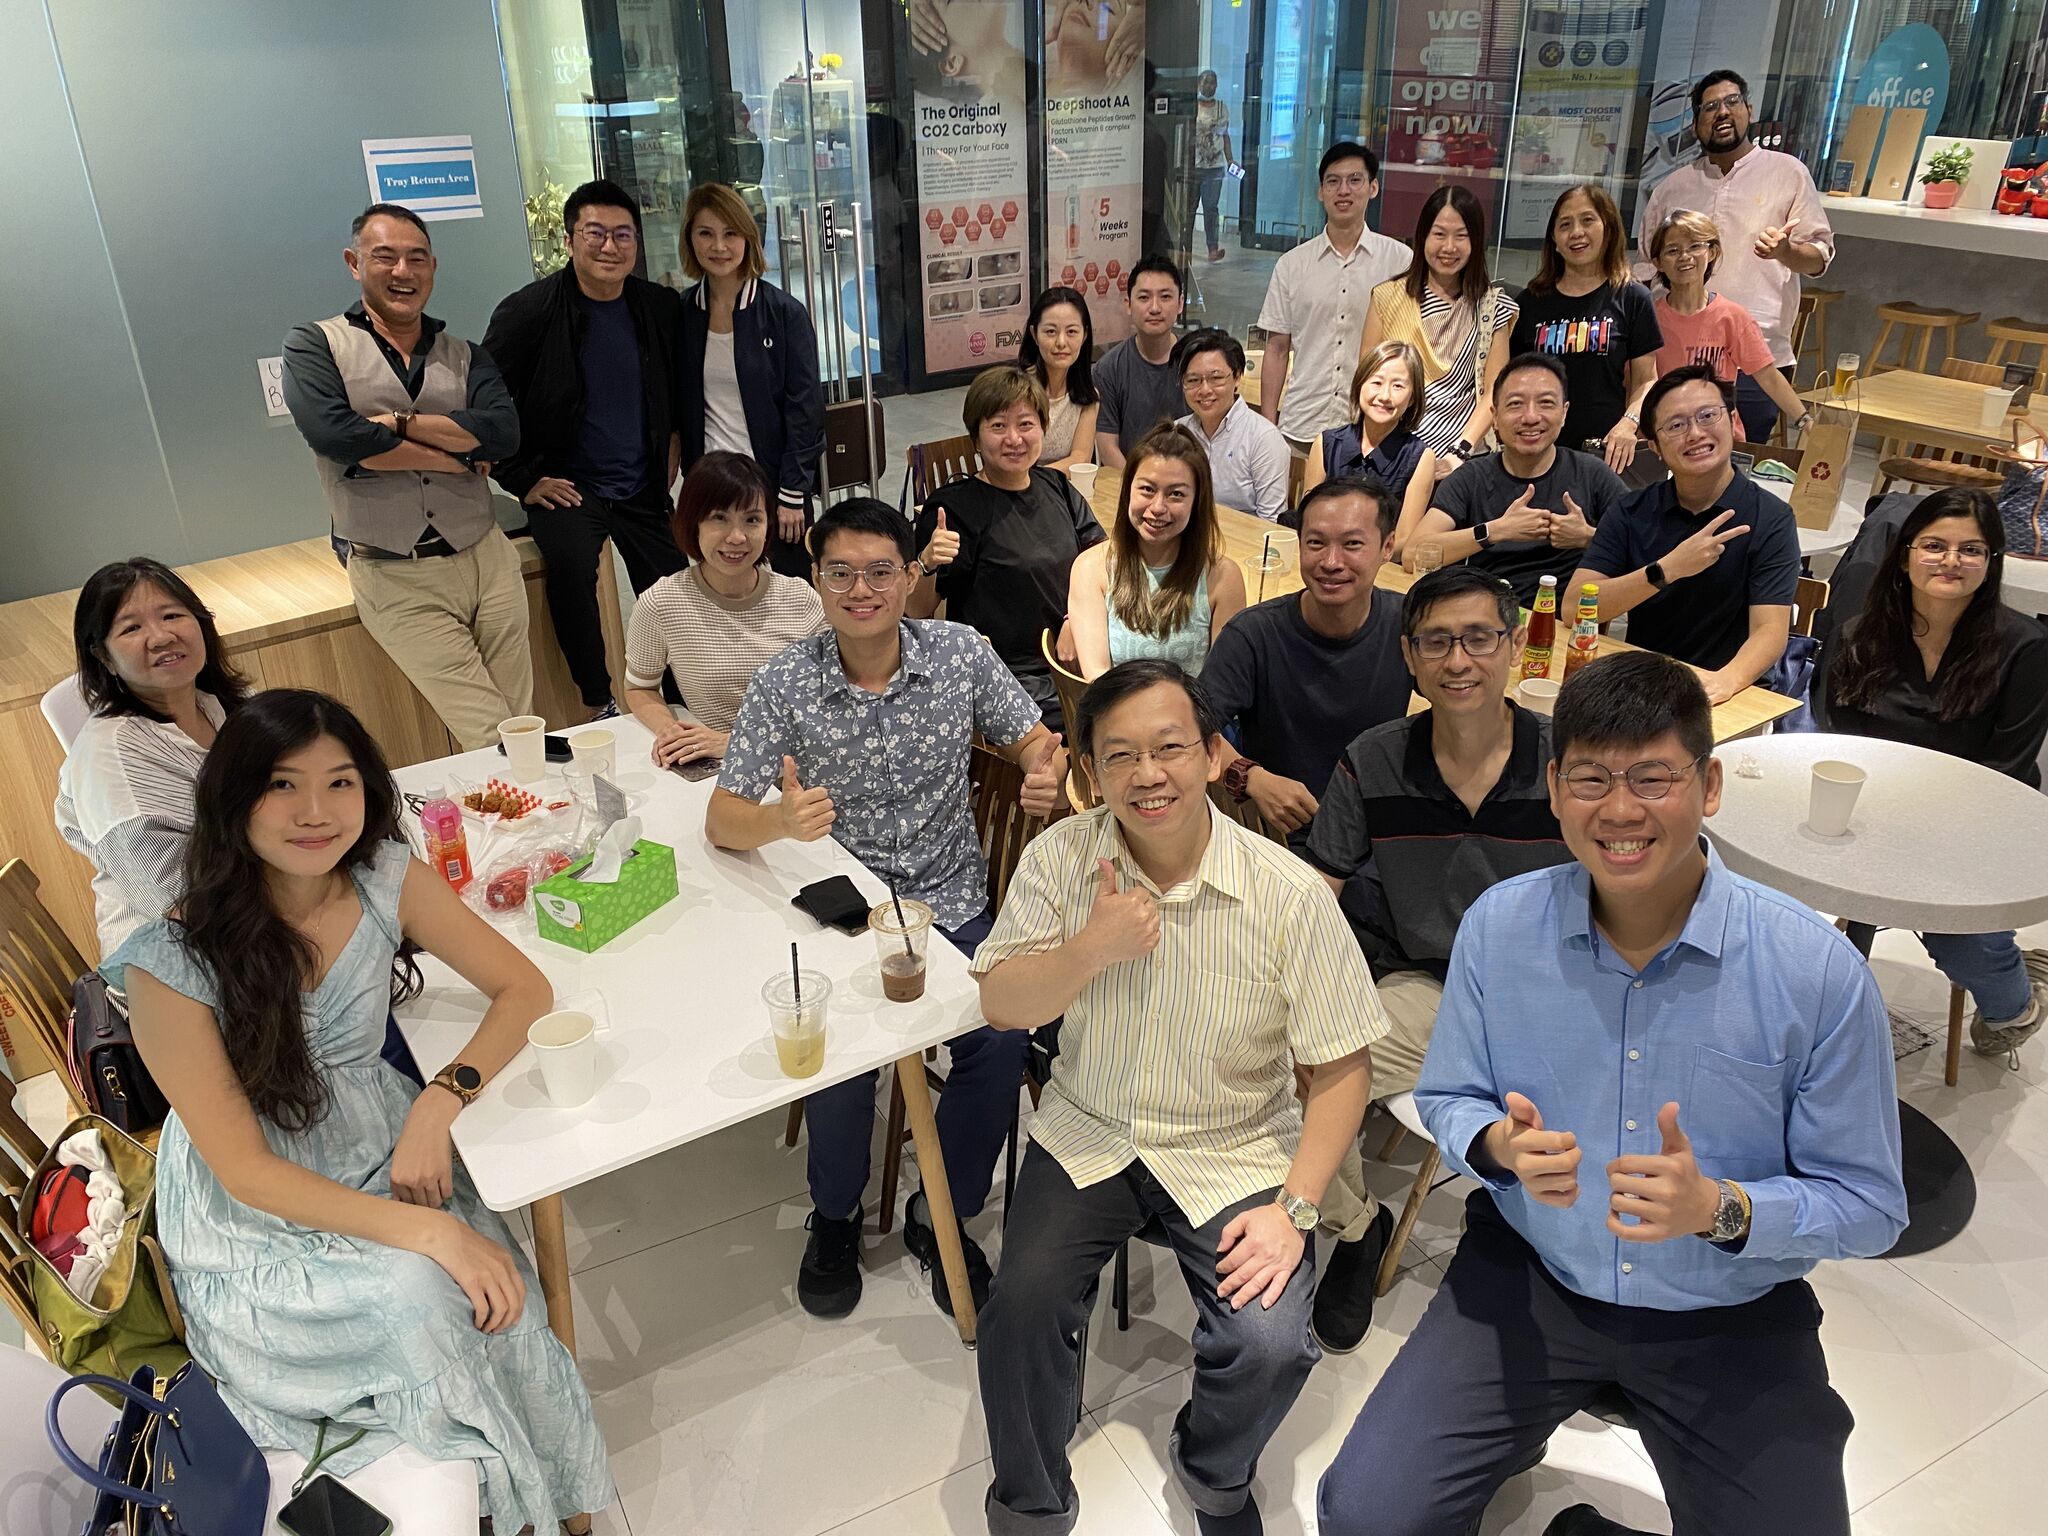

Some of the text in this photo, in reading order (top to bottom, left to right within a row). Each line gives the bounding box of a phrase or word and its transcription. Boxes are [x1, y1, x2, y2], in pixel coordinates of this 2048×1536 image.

[1428, 8, 1481, 31] we
[1401, 80, 1494, 106] open
[921, 102, 1001, 122] The Original
[1047, 95, 1130, 114] Deepshoot AA
[1558, 106, 1621, 115] MOST CHOSEN
[922, 121, 1007, 138] CO2 Carboxy
[1405, 113, 1485, 136] now
[926, 146, 957, 156] Therapy
[959, 145, 971, 153] For
[973, 144, 990, 152] Your
[384, 173, 469, 188] Tray Return Area
[1099, 197, 1110, 218] 5
[1100, 220, 1129, 231] Weeks
[1098, 231, 1129, 242] Program
[995, 330, 1022, 348] FDA
